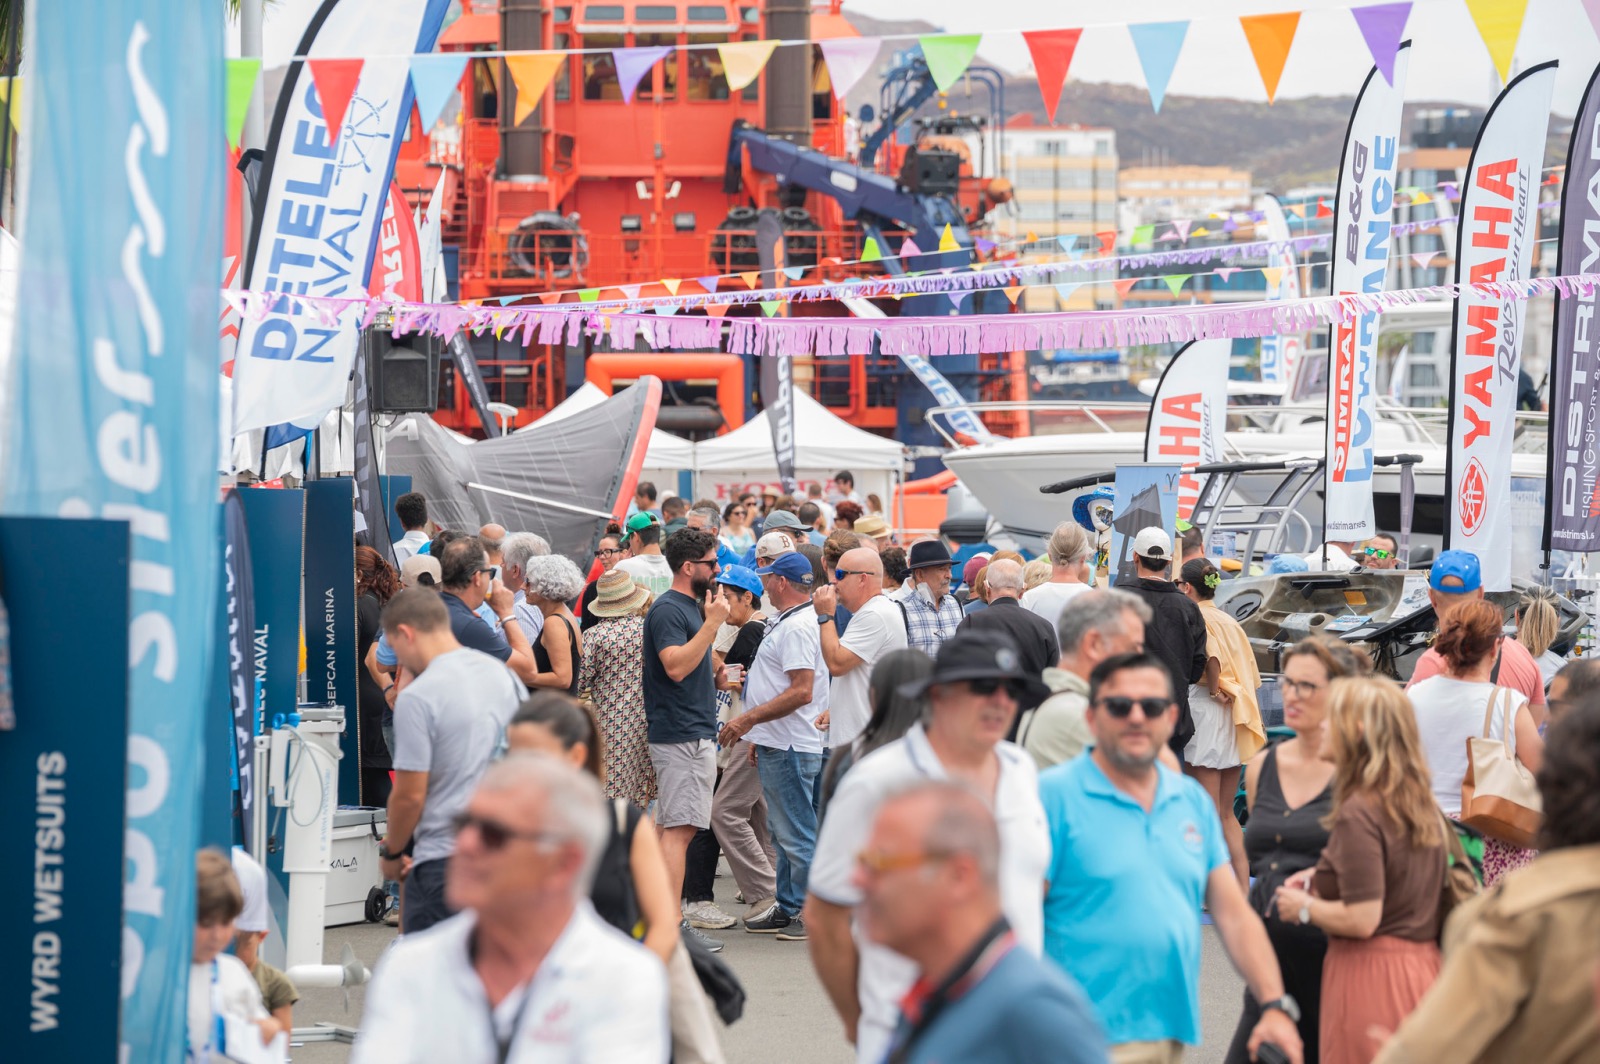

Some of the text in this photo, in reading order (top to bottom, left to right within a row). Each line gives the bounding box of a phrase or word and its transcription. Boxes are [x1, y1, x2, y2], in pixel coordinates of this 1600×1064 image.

[1346, 140, 1368, 266] B&G
[1513, 168, 1529, 240] Heart
[1464, 157, 1518, 449] YAMAHA
[324, 587, 335, 645] MARINA
[29, 751, 67, 1033] WYRD WETSUITS
